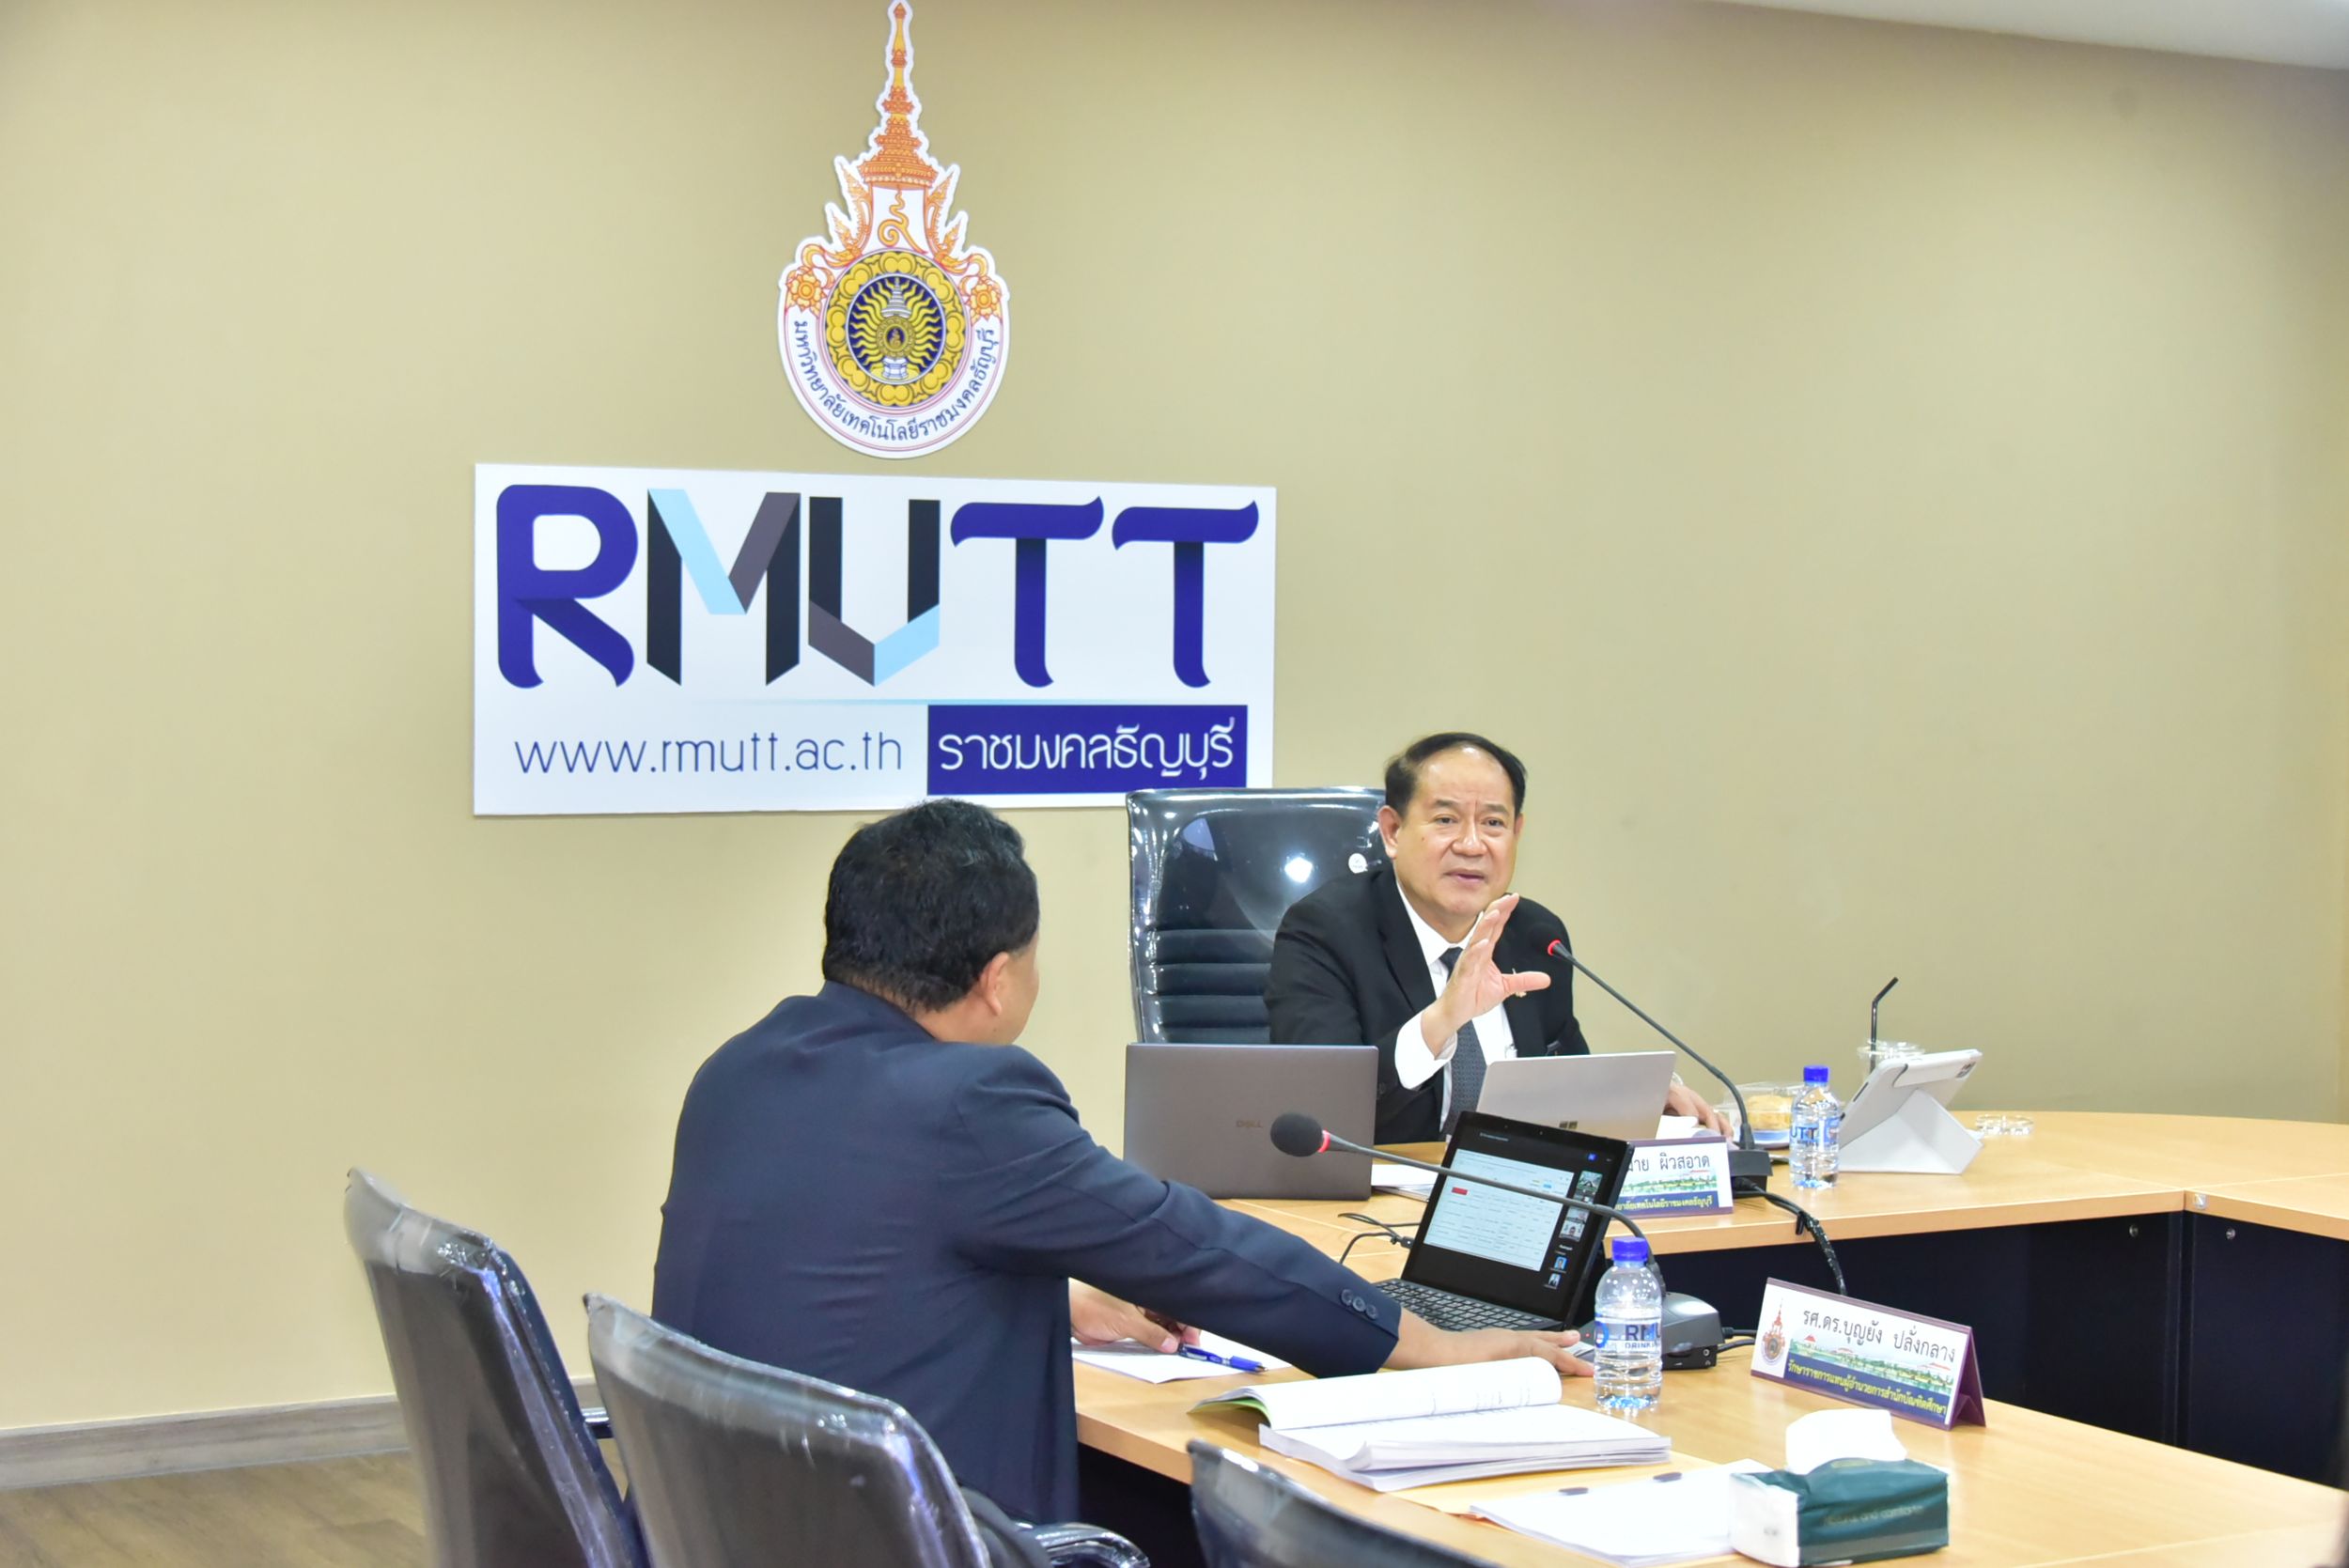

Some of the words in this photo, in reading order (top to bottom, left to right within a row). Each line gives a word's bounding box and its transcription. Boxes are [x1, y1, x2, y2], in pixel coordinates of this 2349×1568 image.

[793, 319, 1001, 442] มหาวิทยาลัยเทคโนโลยีราชมงคลธัญบุรี
[496, 484, 1260, 689] RMUTT
[514, 731, 902, 774] www.rmutt.ac.th
[938, 716, 1237, 781] ราชมงคลธัญบุรี
[1659, 1151, 1711, 1171] ผิวสอาด
[1803, 1309, 1884, 1346] รศ.ดร.บุญยัง
[1893, 1325, 1956, 1363] ปลั่งกลาง
